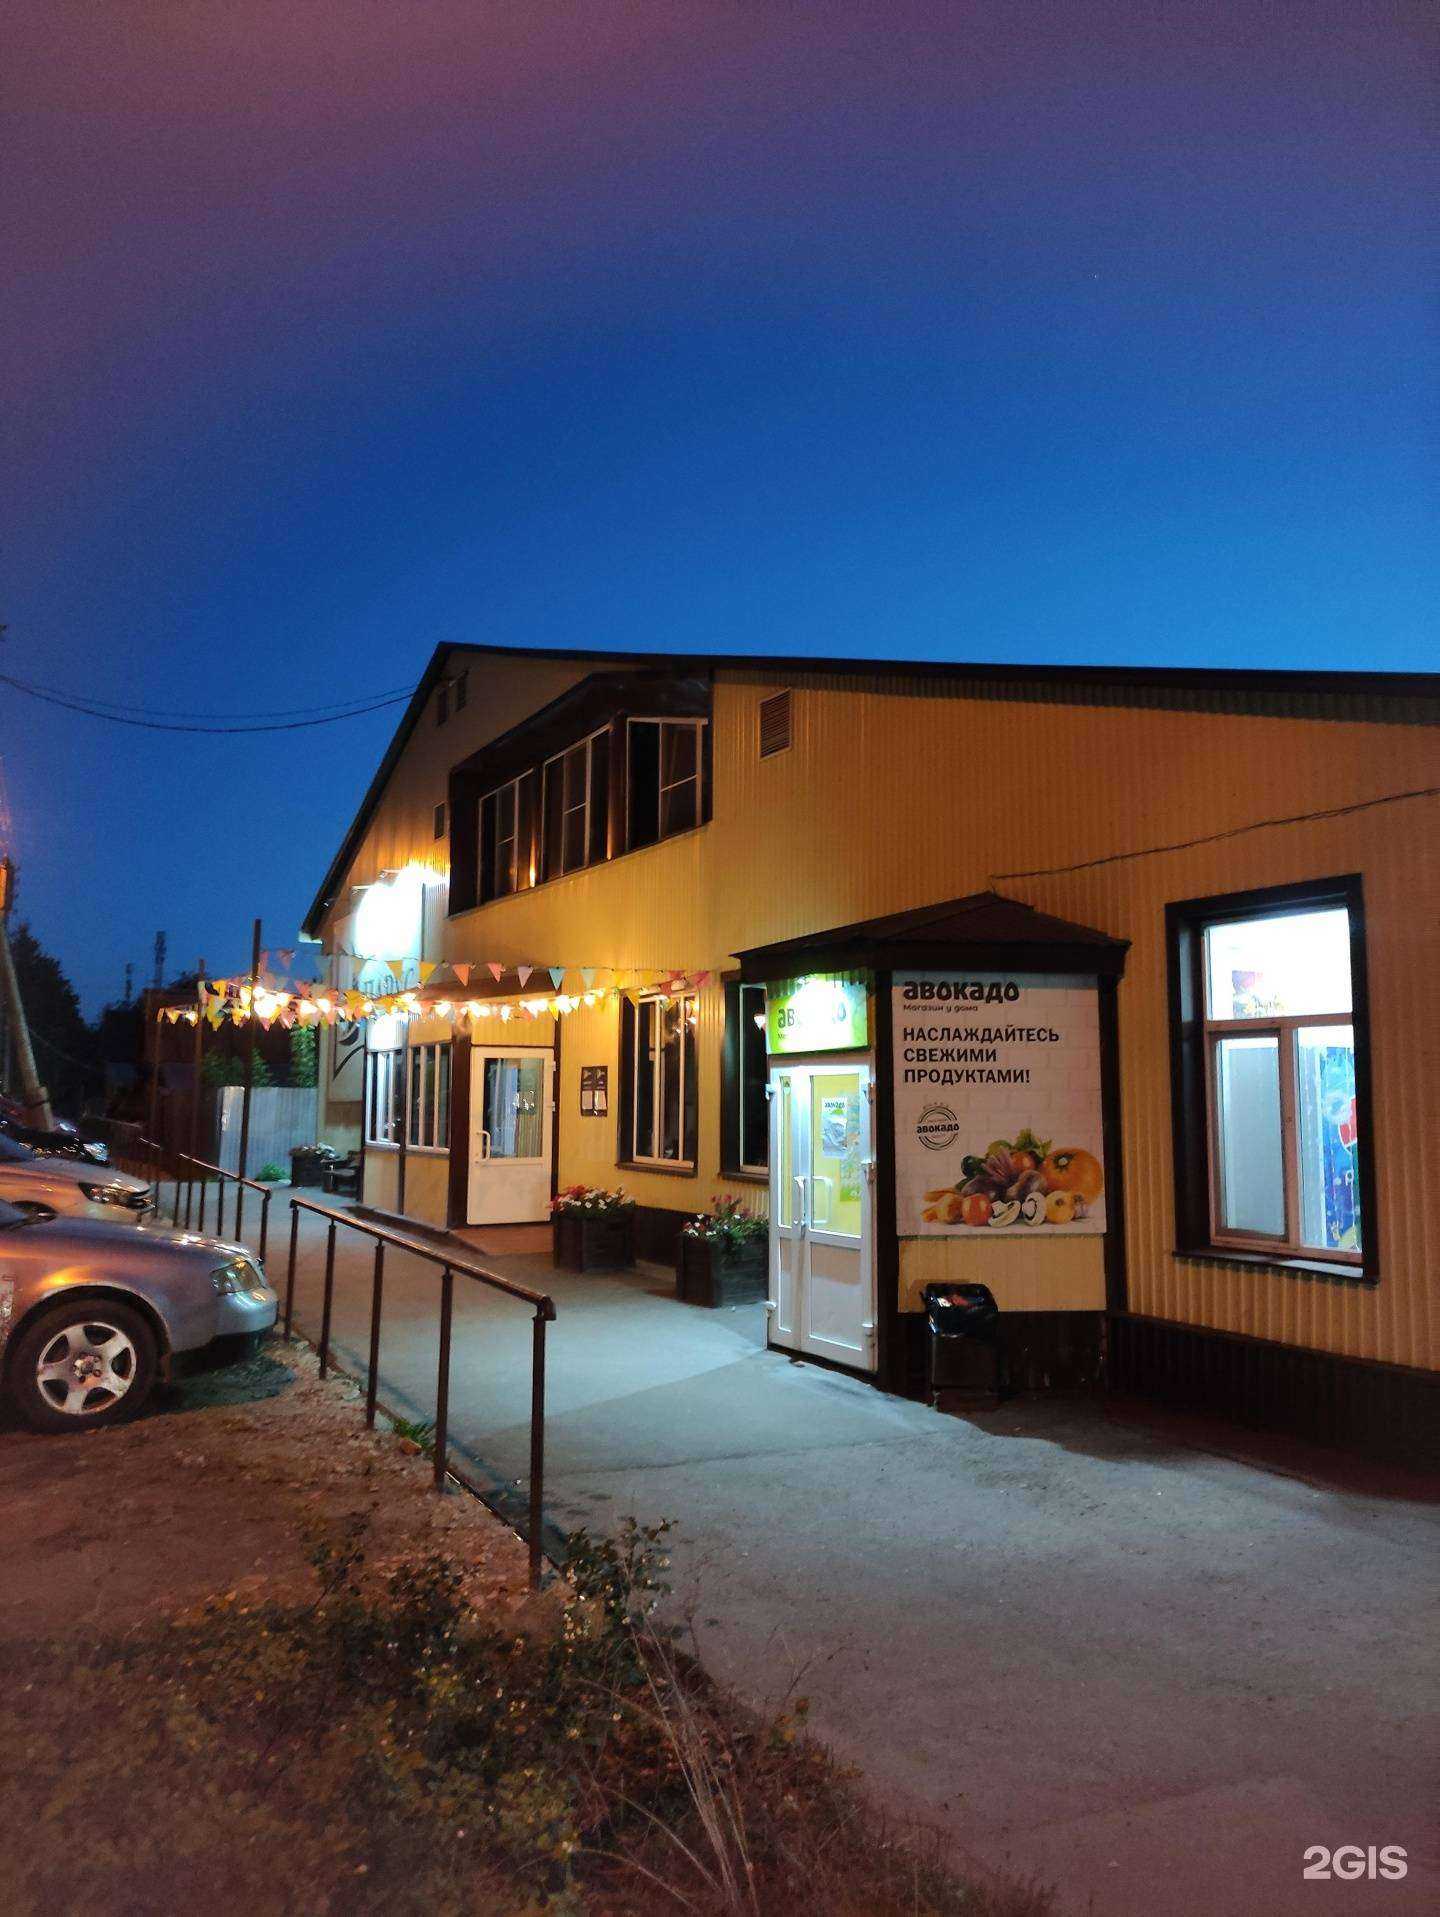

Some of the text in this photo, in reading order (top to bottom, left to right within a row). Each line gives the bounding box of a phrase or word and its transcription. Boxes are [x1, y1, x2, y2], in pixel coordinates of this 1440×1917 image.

[903, 981, 1020, 1004] авокадо
[903, 1025, 1060, 1044] НАСЛАЖДАЙТЕСЬ
[903, 1048, 998, 1063] СВЕЖИМИ
[904, 1069, 1031, 1086] ПРОДУКТАМИ!
[916, 1123, 960, 1134] авокадо
